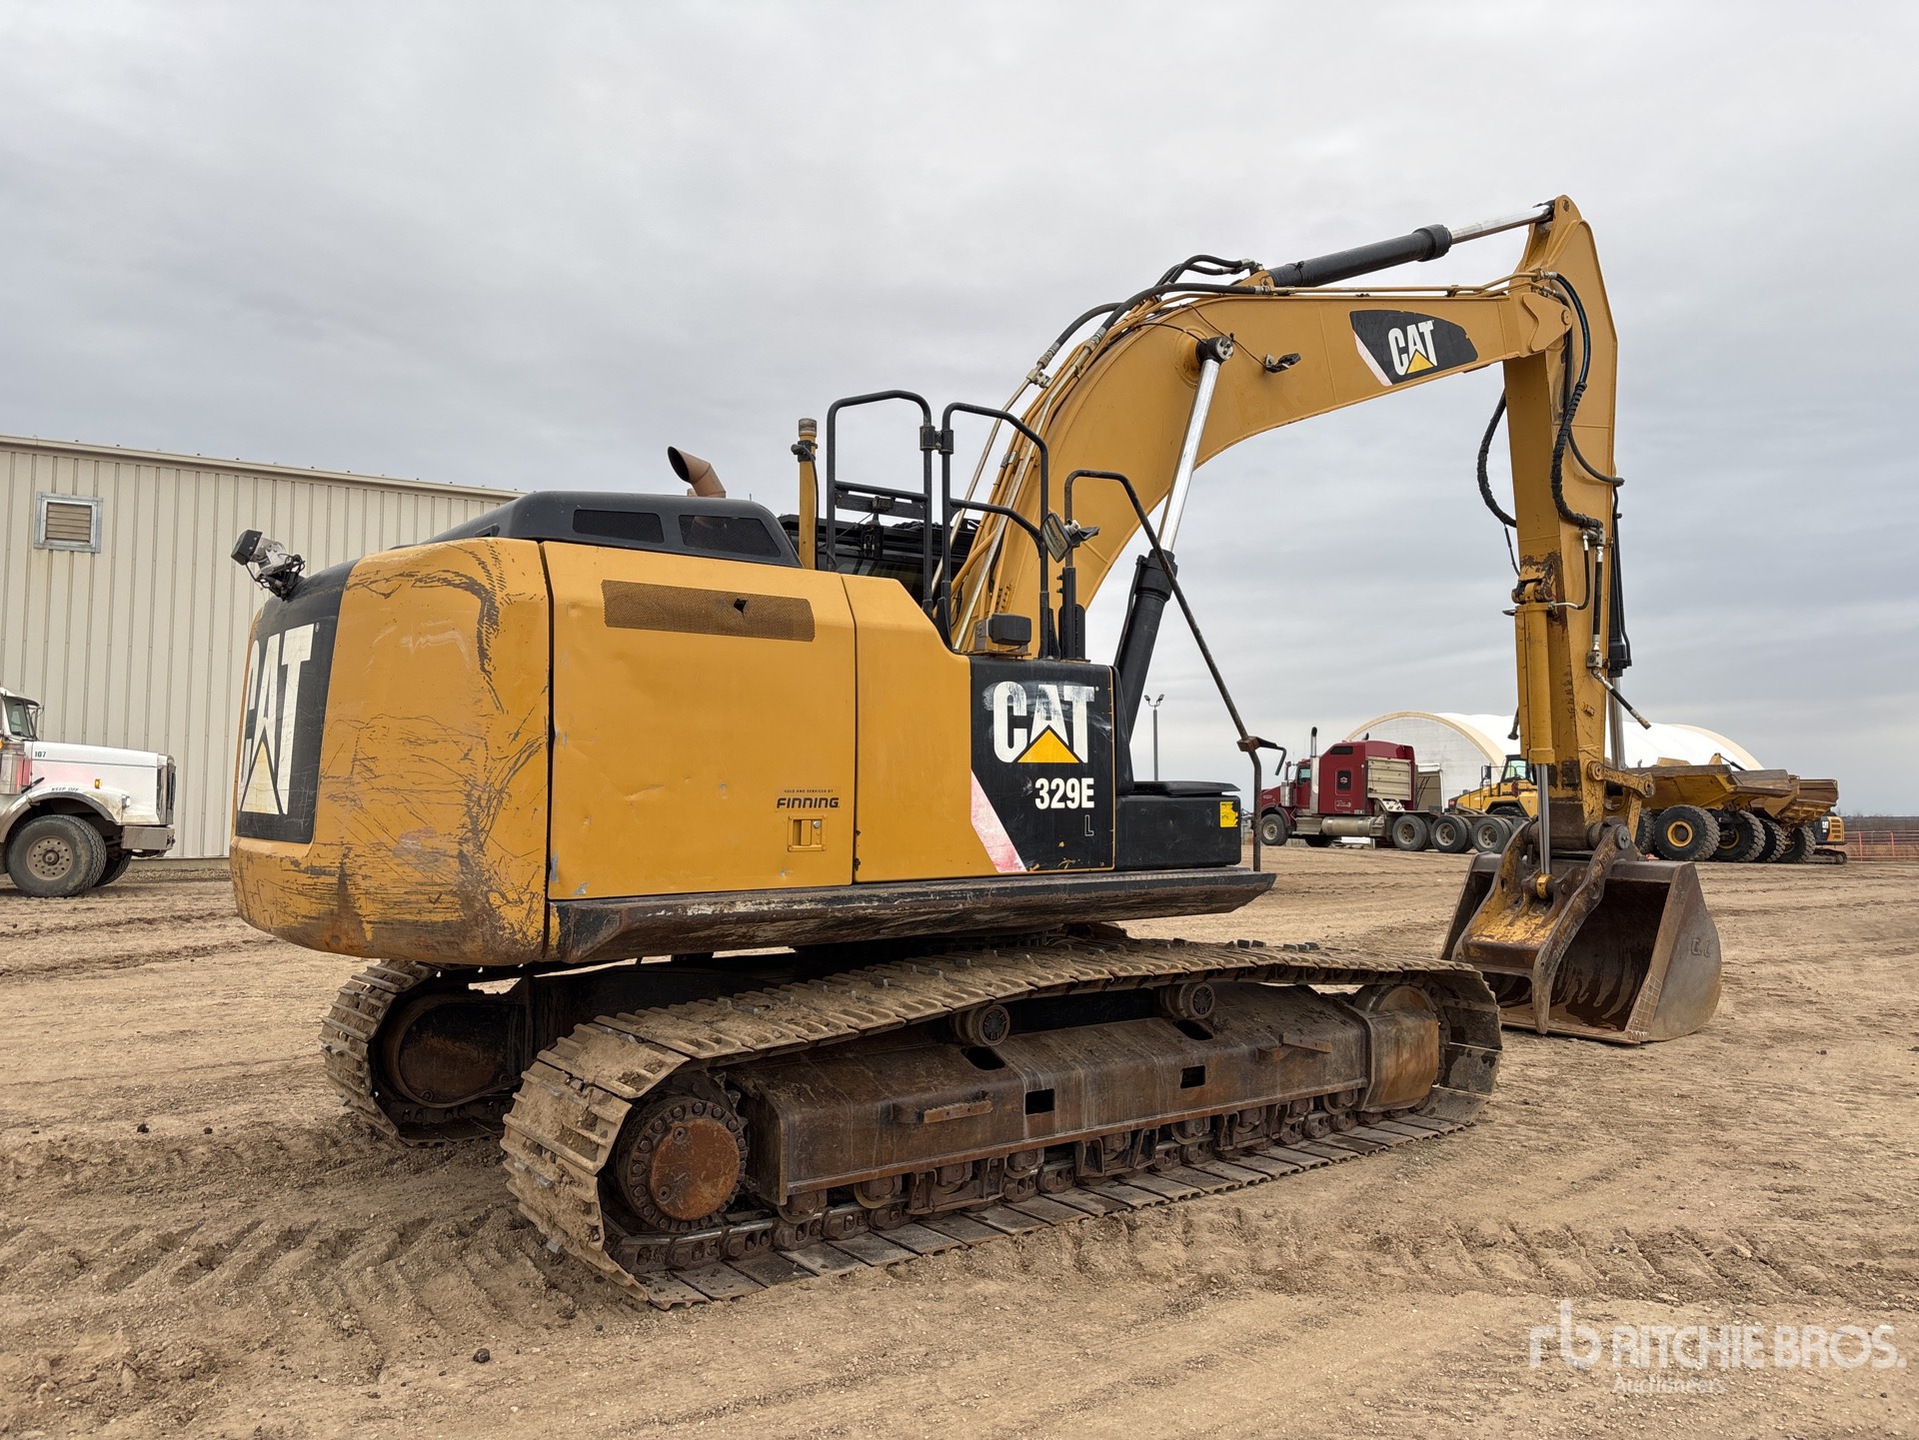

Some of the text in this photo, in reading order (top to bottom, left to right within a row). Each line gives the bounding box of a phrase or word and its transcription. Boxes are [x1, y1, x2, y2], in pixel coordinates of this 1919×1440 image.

[1388, 320, 1437, 376] CAT
[237, 623, 315, 815] CAT
[993, 681, 1095, 764] CAT
[777, 797, 839, 809] FINNING
[1035, 777, 1095, 810] 329E
[1084, 814, 1094, 836] L
